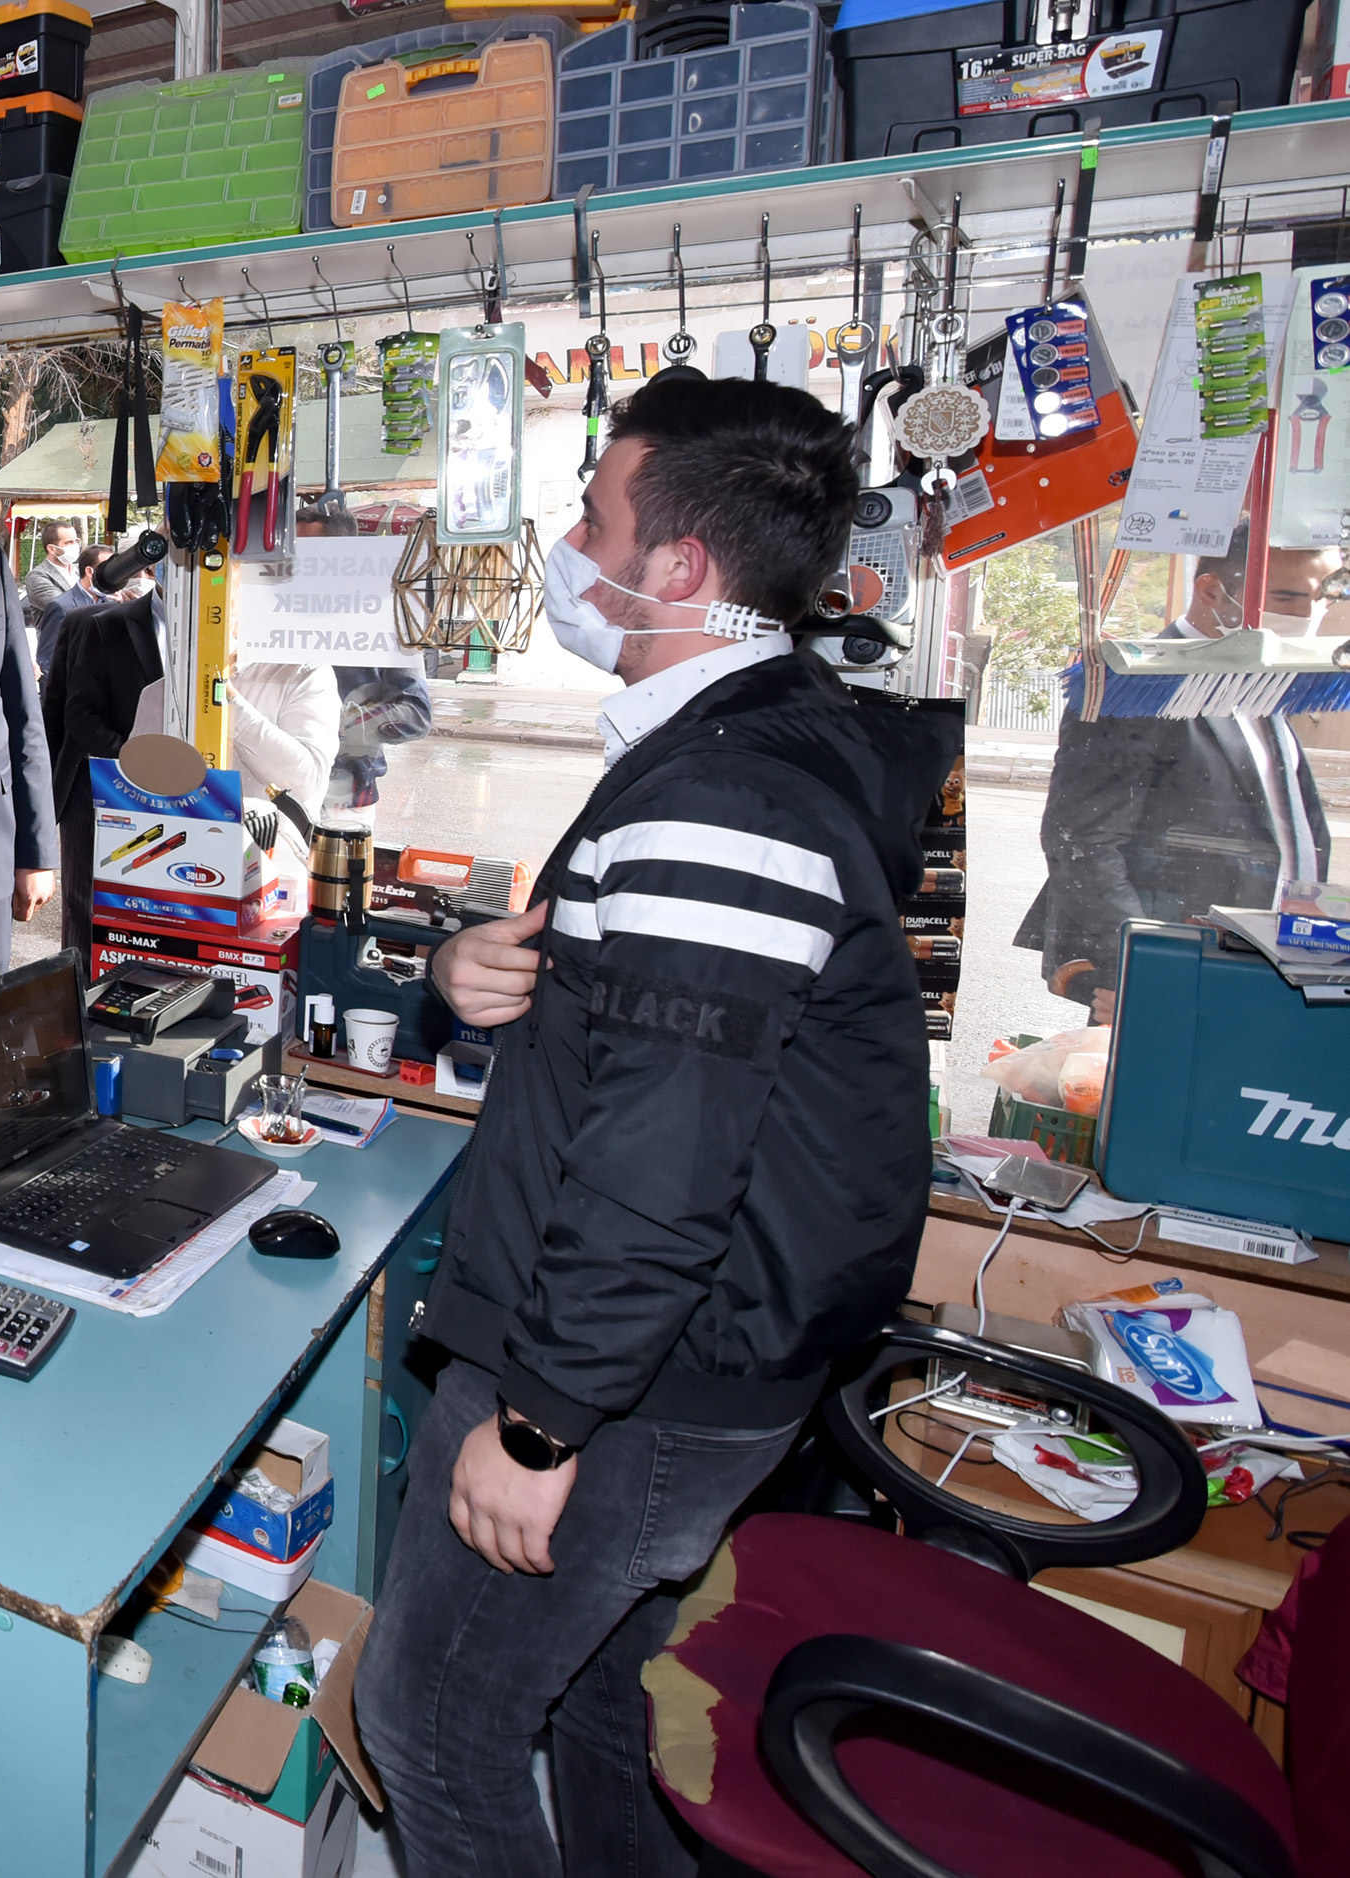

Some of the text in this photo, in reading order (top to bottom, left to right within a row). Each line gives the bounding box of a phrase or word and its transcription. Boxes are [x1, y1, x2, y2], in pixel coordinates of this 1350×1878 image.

[1012, 44, 1087, 67] SUPER-BAG
[1198, 299, 1220, 310] GP
[149, 797, 188, 809] MAKET
[185, 871, 207, 883] SOLID
[372, 885, 416, 898] axExtra
[905, 917, 949, 925] DURACELL
[108, 932, 158, 948] BUL-MAX
[218, 951, 265, 964] BMX-673
[590, 981, 727, 1042] BLACK
[1124, 1366, 1137, 1383] 100
